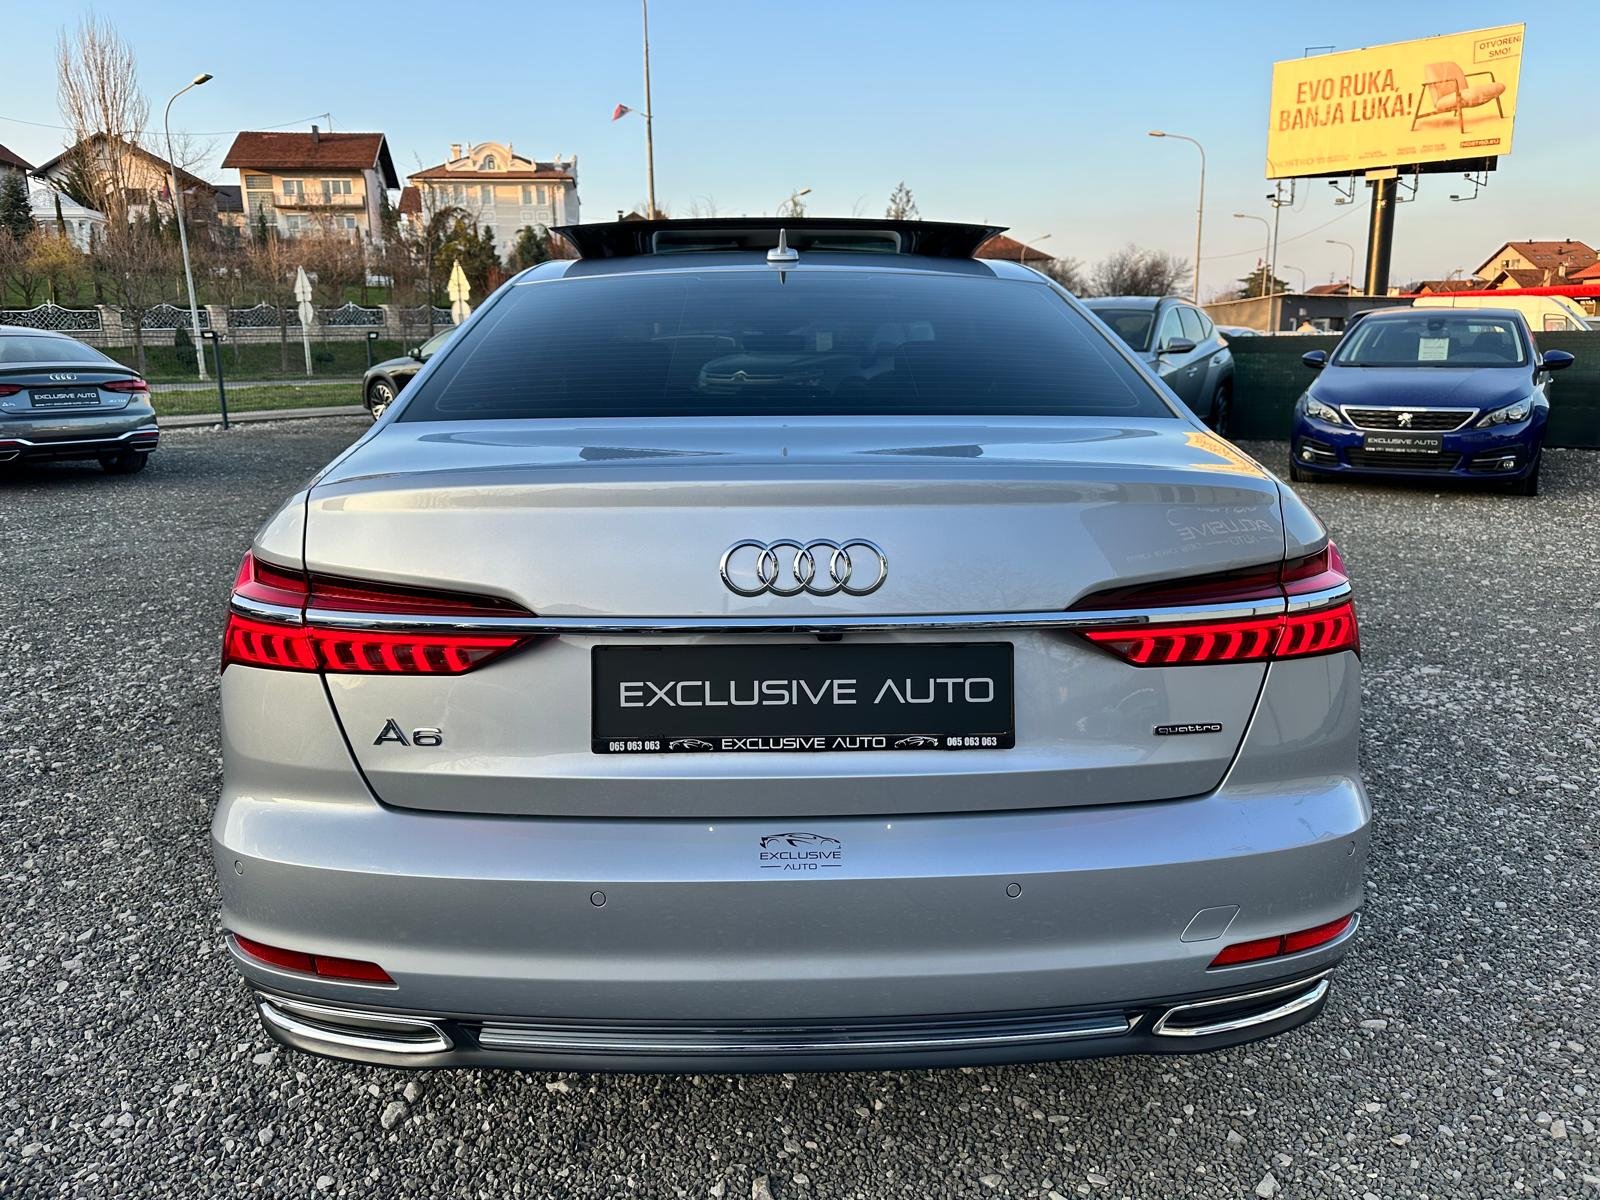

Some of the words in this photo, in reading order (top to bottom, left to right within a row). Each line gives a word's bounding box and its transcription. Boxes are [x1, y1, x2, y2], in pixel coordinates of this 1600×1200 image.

[1489, 47, 1511, 58] SMO!
[1296, 78, 1339, 104] EVO
[1339, 68, 1400, 99] RUKA,
[1279, 101, 1344, 132] BANJA
[1351, 93, 1413, 123] LUKA!
[1367, 437, 1412, 445] EXCLUSIVE
[619, 679, 857, 707] EXCLUSIVE
[873, 677, 994, 705] AUTO
[372, 718, 443, 747] A6
[1157, 725, 1221, 735] quattro
[609, 741, 625, 751] 065
[627, 741, 643, 751] 063
[644, 740, 660, 750] 063
[721, 737, 826, 750] EXCLUSIVE
[832, 736, 886, 749] AUTO
[946, 736, 962, 747] 065
[964, 736, 980, 746] 063
[981, 735, 997, 746] 063
[760, 851, 842, 860] EXCLUSIVE
[783, 863, 818, 871] AUTO
